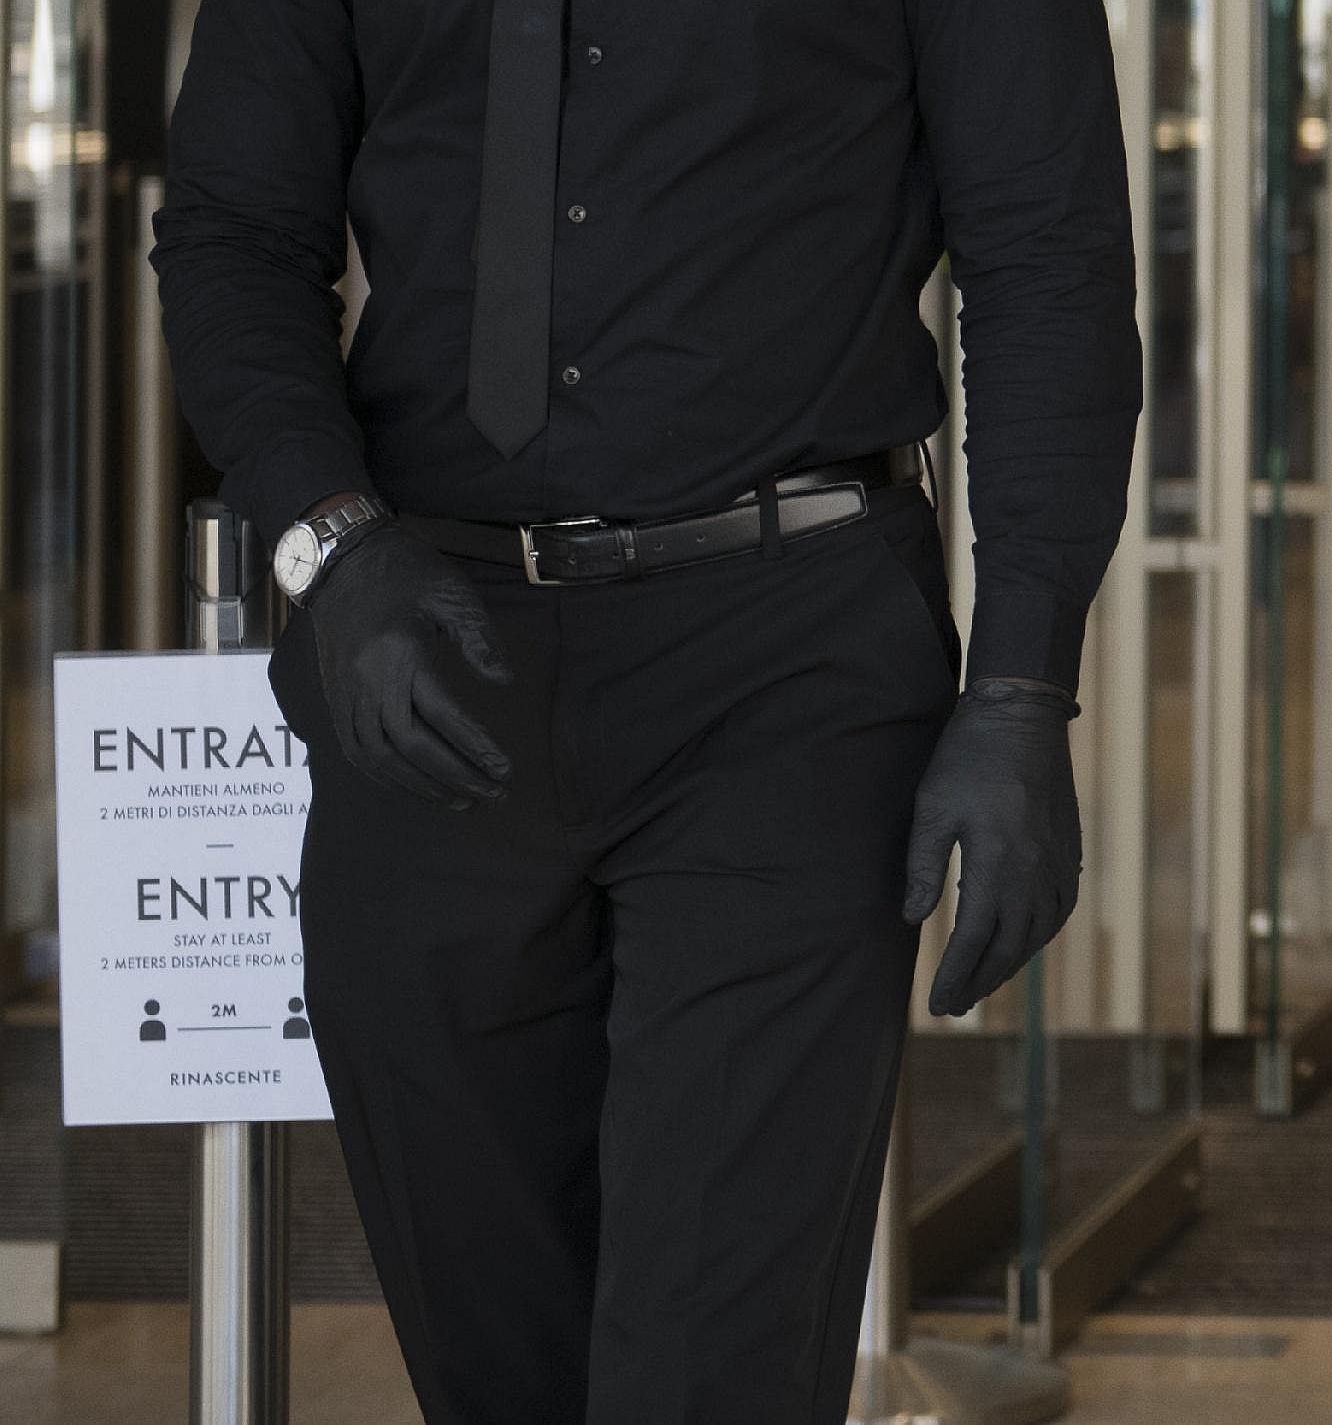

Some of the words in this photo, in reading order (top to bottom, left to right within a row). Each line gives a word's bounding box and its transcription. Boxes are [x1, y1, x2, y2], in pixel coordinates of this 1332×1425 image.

[92, 724, 310, 773] ENTRAT
[147, 784, 218, 798] MANTIENI
[223, 782, 285, 796] ALMENO
[100, 807, 108, 820] 2
[113, 806, 154, 820] METRI
[158, 806, 172, 818] DI
[177, 804, 248, 818] DISTANZA
[252, 803, 293, 816] DAGLI
[137, 874, 301, 921] ENTRY
[174, 934, 206, 947] STAY
[211, 934, 225, 945] AT
[231, 932, 271, 945] LEAST
[101, 958, 109, 970] 2
[114, 956, 167, 969] METERS
[171, 954, 240, 969] DISTANCE
[245, 953, 286, 967] FROM
[211, 1003, 237, 1018] 2M
[170, 1069, 281, 1086] RINASCENTE
